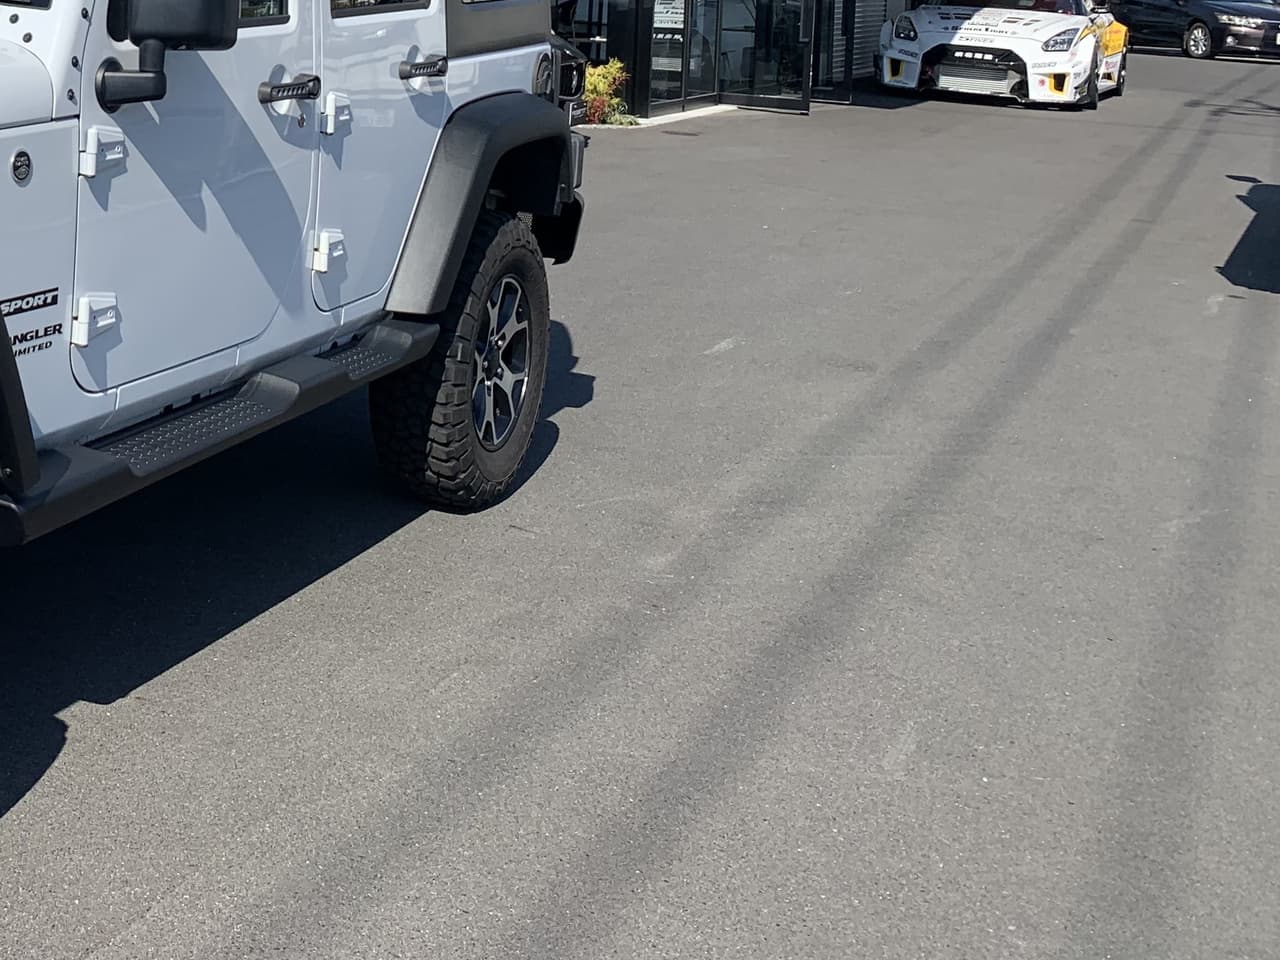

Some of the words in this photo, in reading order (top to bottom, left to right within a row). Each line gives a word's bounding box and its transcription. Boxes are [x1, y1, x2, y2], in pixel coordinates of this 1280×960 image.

[0, 291, 58, 315] SPORT
[10, 323, 63, 345] NGLER
[14, 341, 53, 357] IMITED
